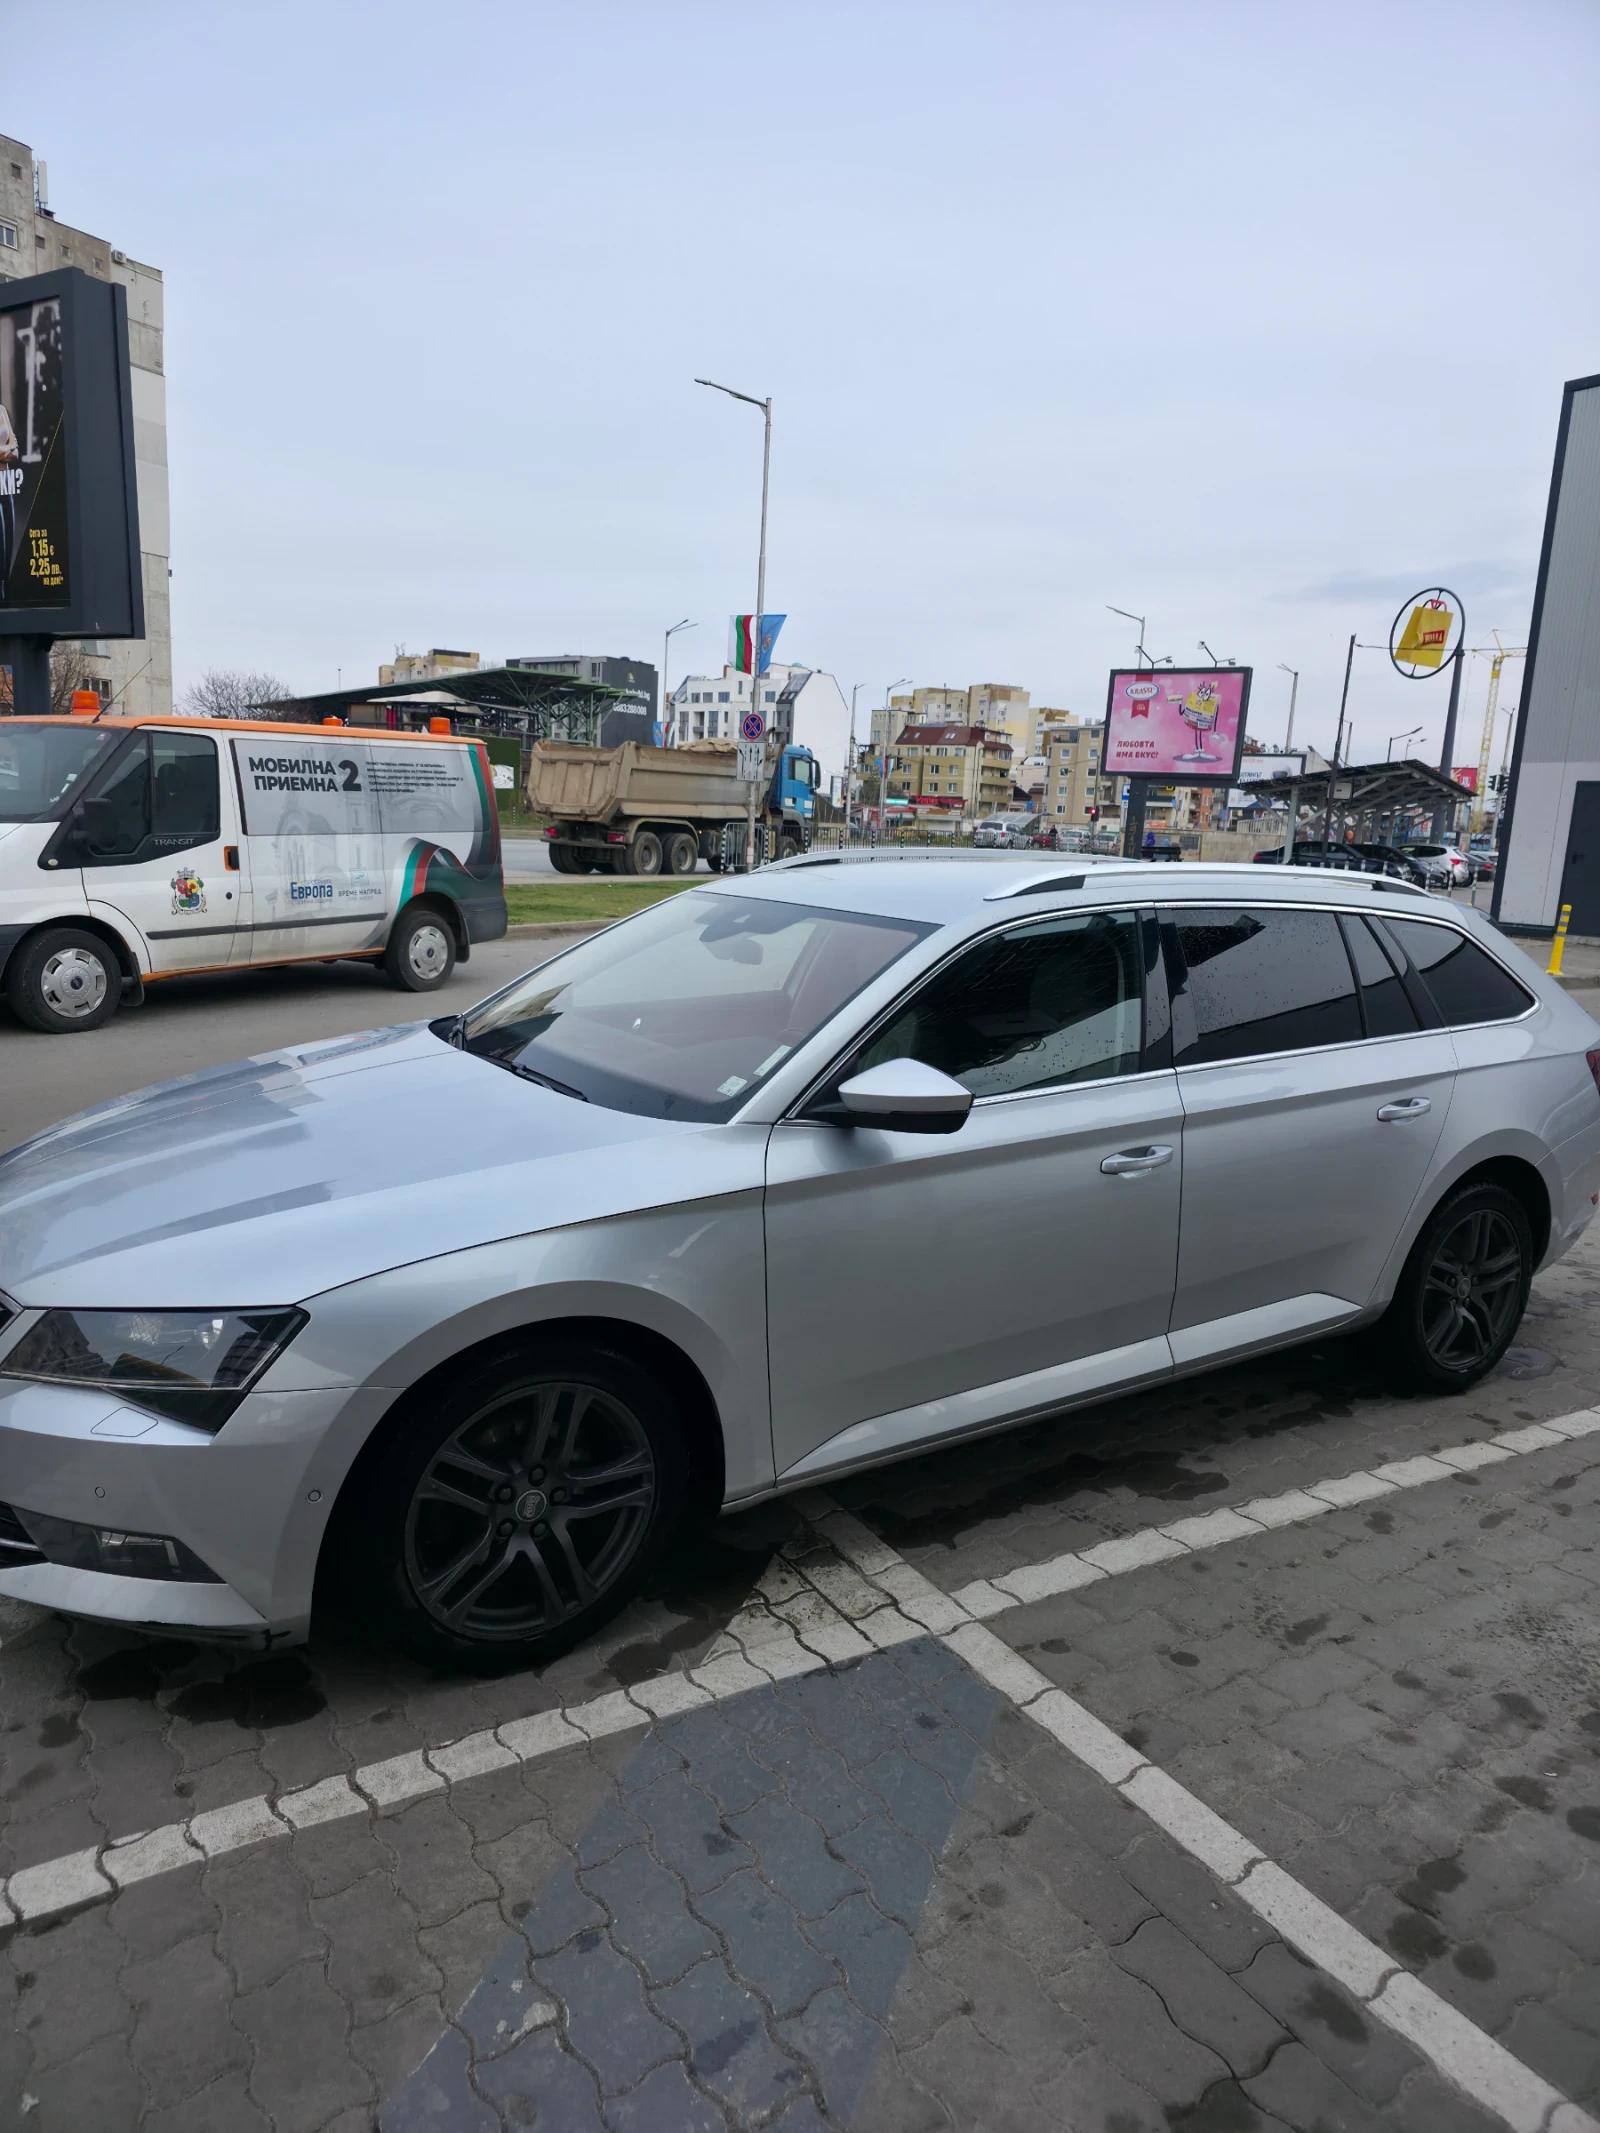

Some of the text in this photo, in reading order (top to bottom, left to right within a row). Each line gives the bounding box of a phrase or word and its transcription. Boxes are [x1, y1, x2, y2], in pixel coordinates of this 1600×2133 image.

[41, 528, 48, 538] за
[31, 539, 48, 558] 1,15
[30, 558, 50, 577] 2,25
[43, 576, 50, 586] на
[1425, 632, 1443, 643] BILLA
[1116, 740, 1155, 749] ЛЮБОВТА
[1116, 751, 1159, 760] ИМА ВКУС!
[248, 756, 362, 792] МОБИЛНА 2
[254, 775, 339, 793] ПРИЕМНА
[154, 837, 195, 846] TRANSIT
[290, 881, 333, 900] Европа
[338, 888, 383, 898] ВРЕМЕ НАПРЕД
